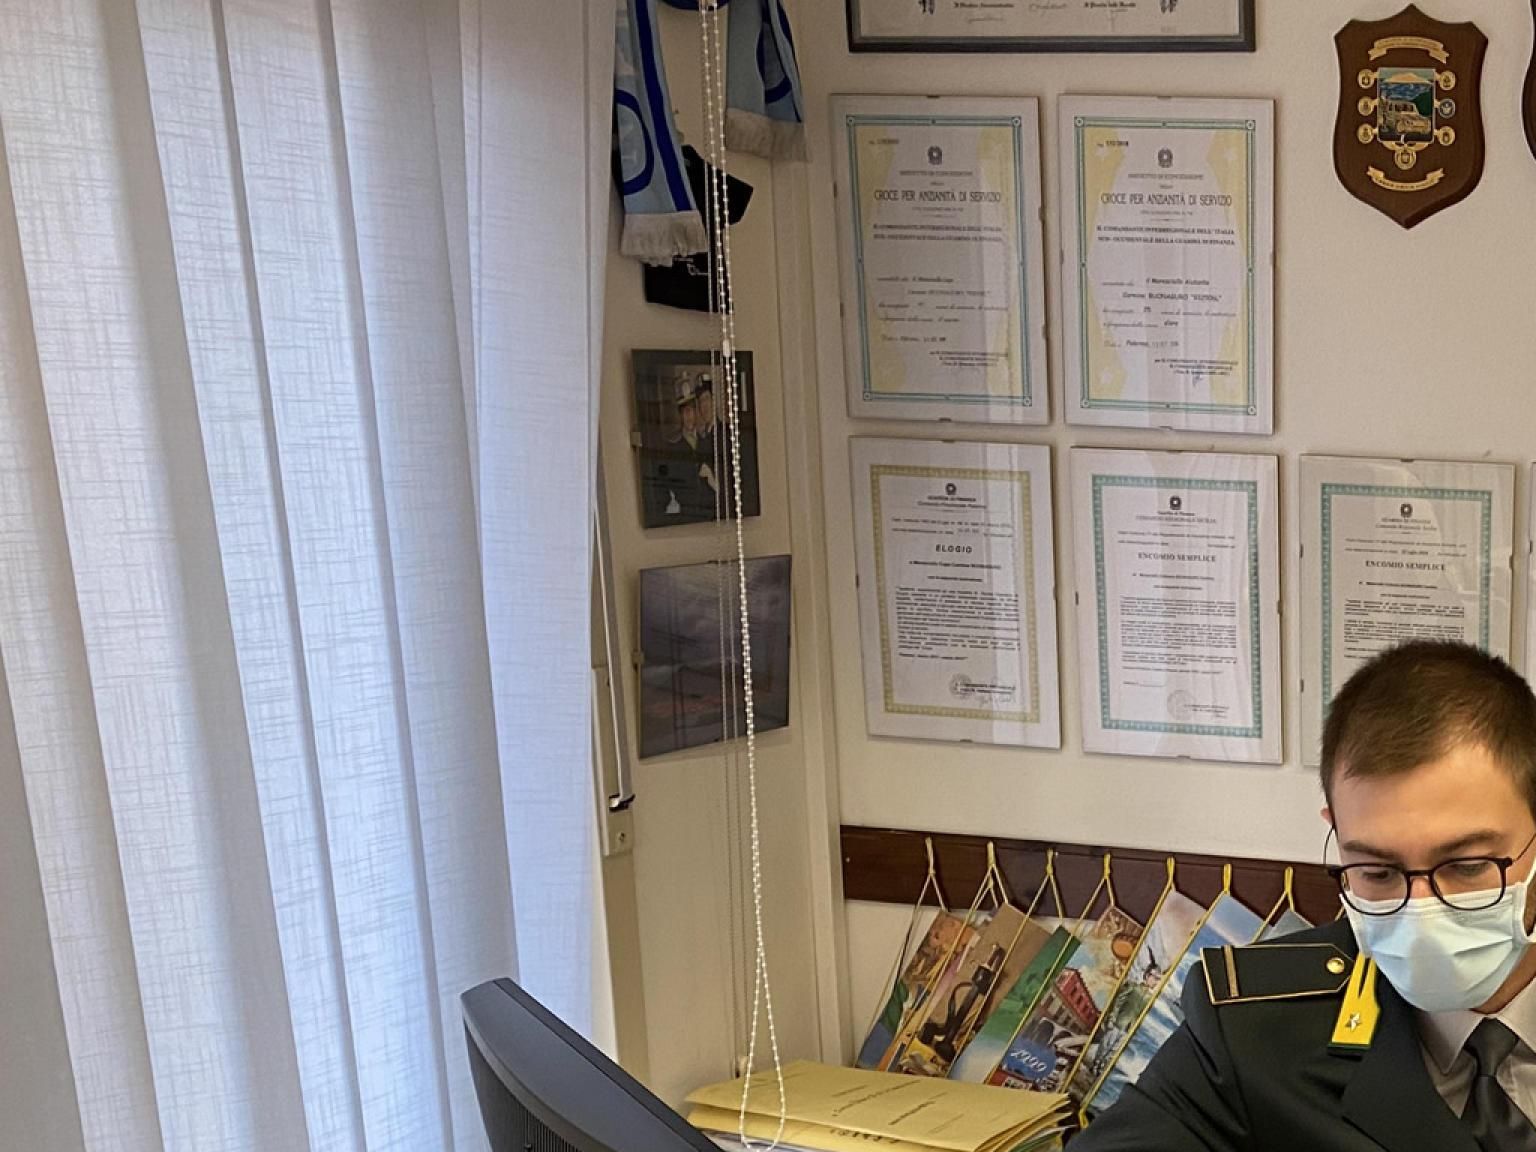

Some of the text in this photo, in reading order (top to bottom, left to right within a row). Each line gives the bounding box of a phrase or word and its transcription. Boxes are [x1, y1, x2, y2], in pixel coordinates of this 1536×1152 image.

[874, 190, 898, 201] CROCE
[901, 190, 915, 201] PER
[959, 191, 967, 201] DI
[970, 191, 1000, 202] SERVIZIO
[1101, 193, 1127, 204] CROCE
[1129, 193, 1144, 204] PER
[1188, 195, 1197, 205] DI
[1200, 195, 1232, 206] SERVIZIO
[936, 544, 973, 553] ELOGIO
[1138, 552, 1216, 562] ENCOMIO SEMPLICE
[1366, 560, 1445, 571] ENCOMIO SEMPLICE
